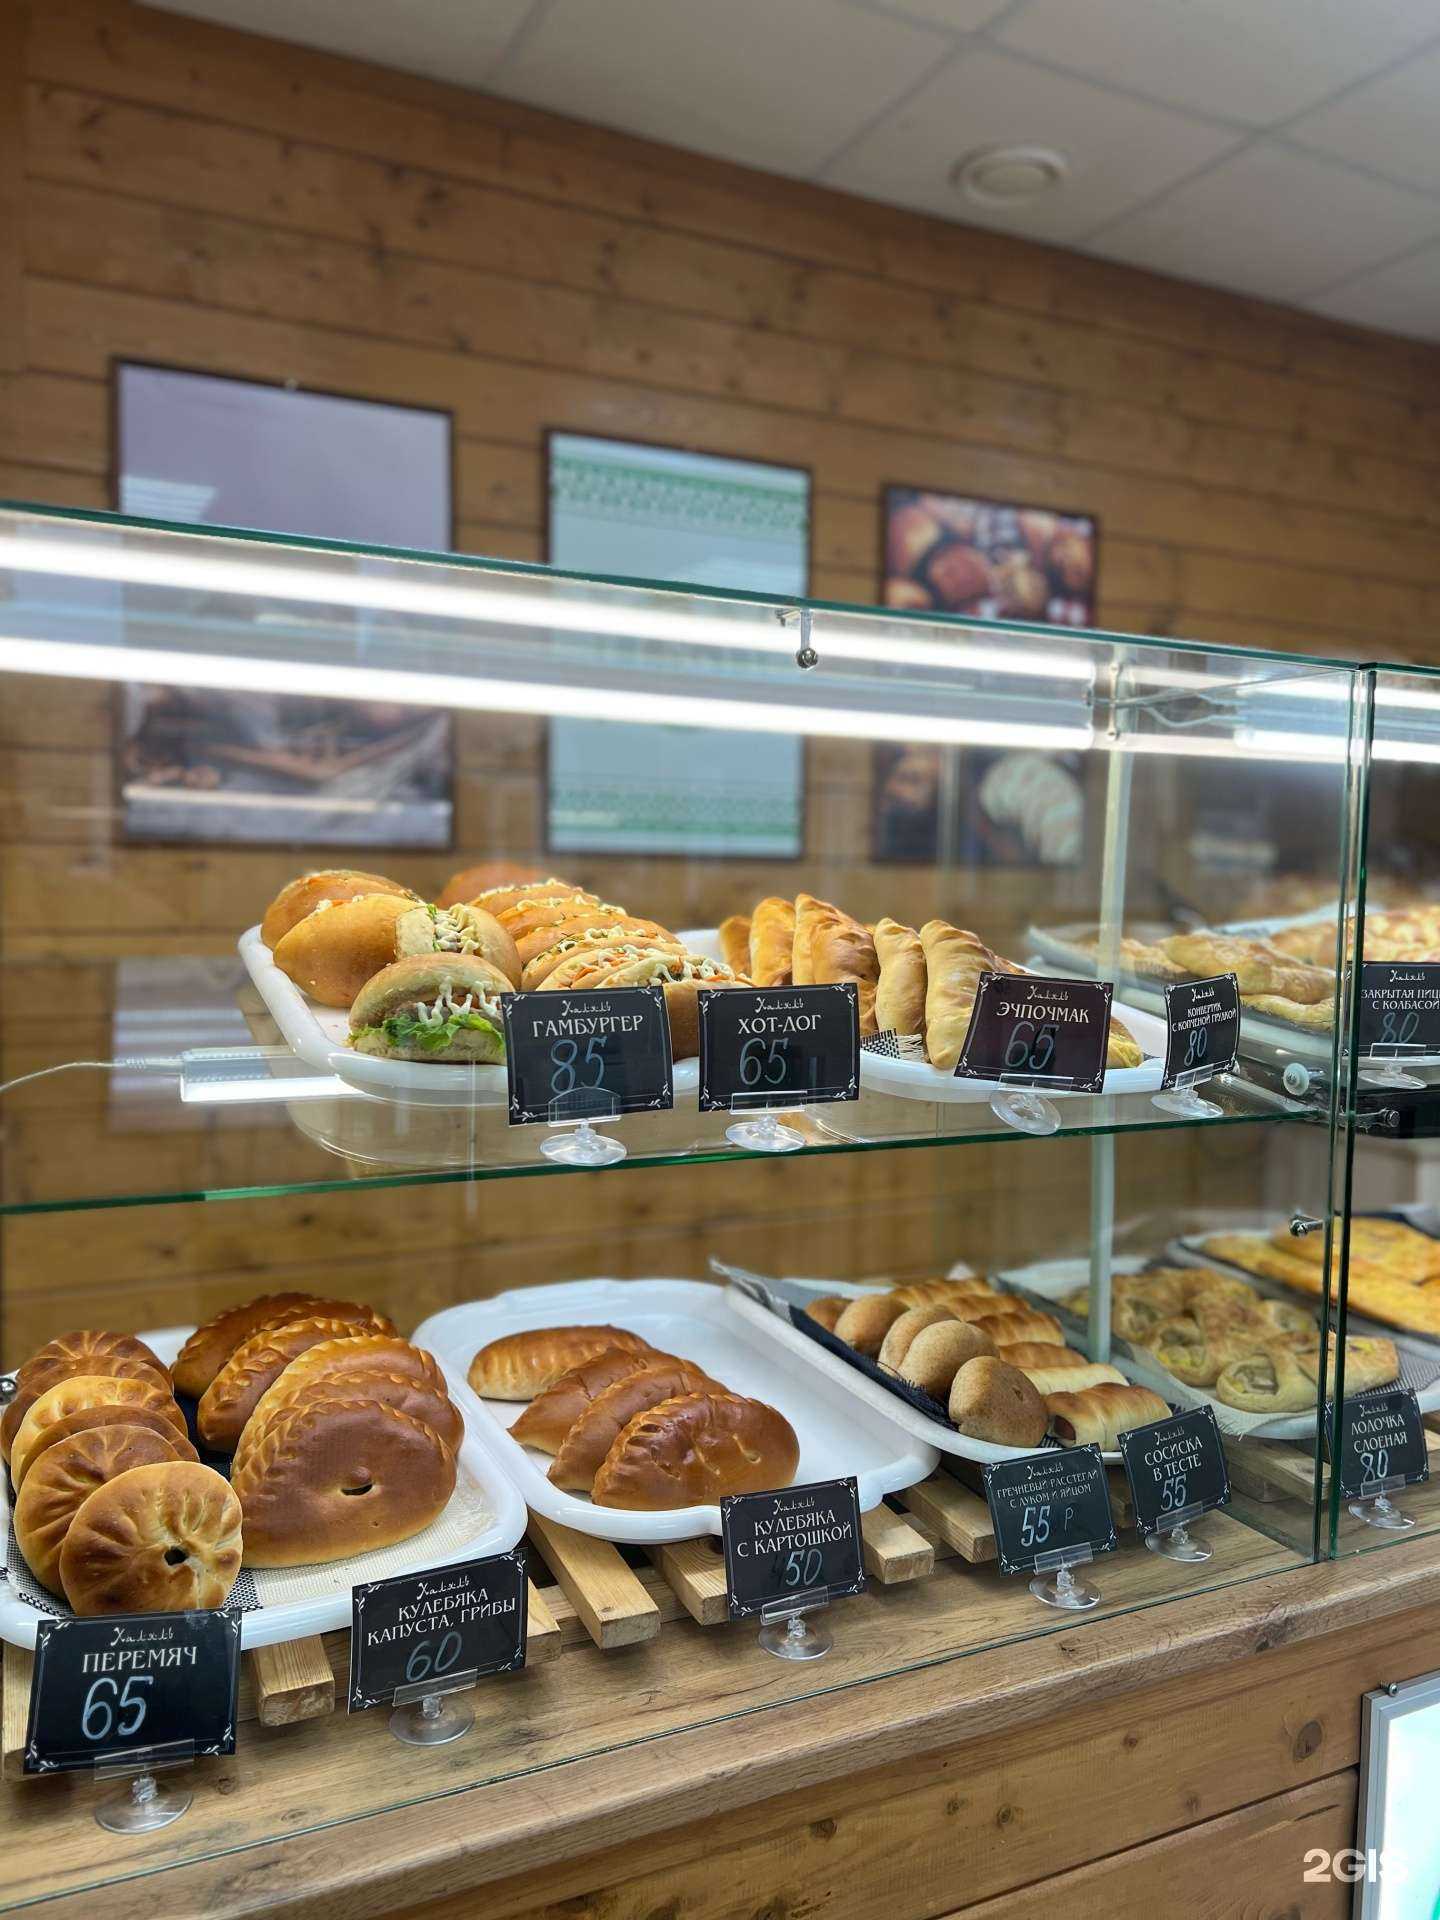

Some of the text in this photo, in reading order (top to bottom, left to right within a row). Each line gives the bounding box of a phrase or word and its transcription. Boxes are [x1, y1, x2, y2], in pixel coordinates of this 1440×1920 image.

[1361, 989, 1440, 999] ЗАКРЫТАЯ ПИЦ
[1372, 999, 1440, 1010] С КОЛБАСОЙ
[738, 1015, 821, 1034] ХОТ-ДОГ
[997, 1002, 1090, 1024] ЭЧПОЧМАК
[1188, 1002, 1222, 1018] КОНВЕРТИК
[532, 1015, 643, 1037] ГАМБУРГЕР
[1172, 1022, 1177, 1032] С
[1380, 1012, 1420, 1043] 80
[740, 1037, 789, 1085] 65
[1005, 1021, 1060, 1070] 65
[1184, 1027, 1208, 1067] 80
[551, 1035, 608, 1095] 85
[1144, 1435, 1203, 1466] СОСИСКА
[1353, 1431, 1408, 1453] СЛОЕНАЯ
[1153, 1453, 1201, 1481] В ТЕСТЕ
[1360, 1449, 1389, 1483] 80
[1009, 1499, 1017, 1509] С
[1019, 1492, 1050, 1507] ЛУКОМ
[1052, 1490, 1058, 1499] И
[1160, 1473, 1187, 1511] 55
[754, 1509, 836, 1536] КУЛЕБЯКА
[1020, 1505, 1051, 1547] 55
[737, 1521, 853, 1557] С КАРТОШКОЙ
[785, 1548, 823, 1586] 50
[398, 1588, 488, 1622] КУЛЕБЯКА
[368, 1597, 515, 1647] КАПУСТА, ГРИБЫ
[82, 1646, 198, 1673] ПЕРЕМЯЧ
[406, 1631, 463, 1682] 60
[82, 1675, 154, 1740] 65
